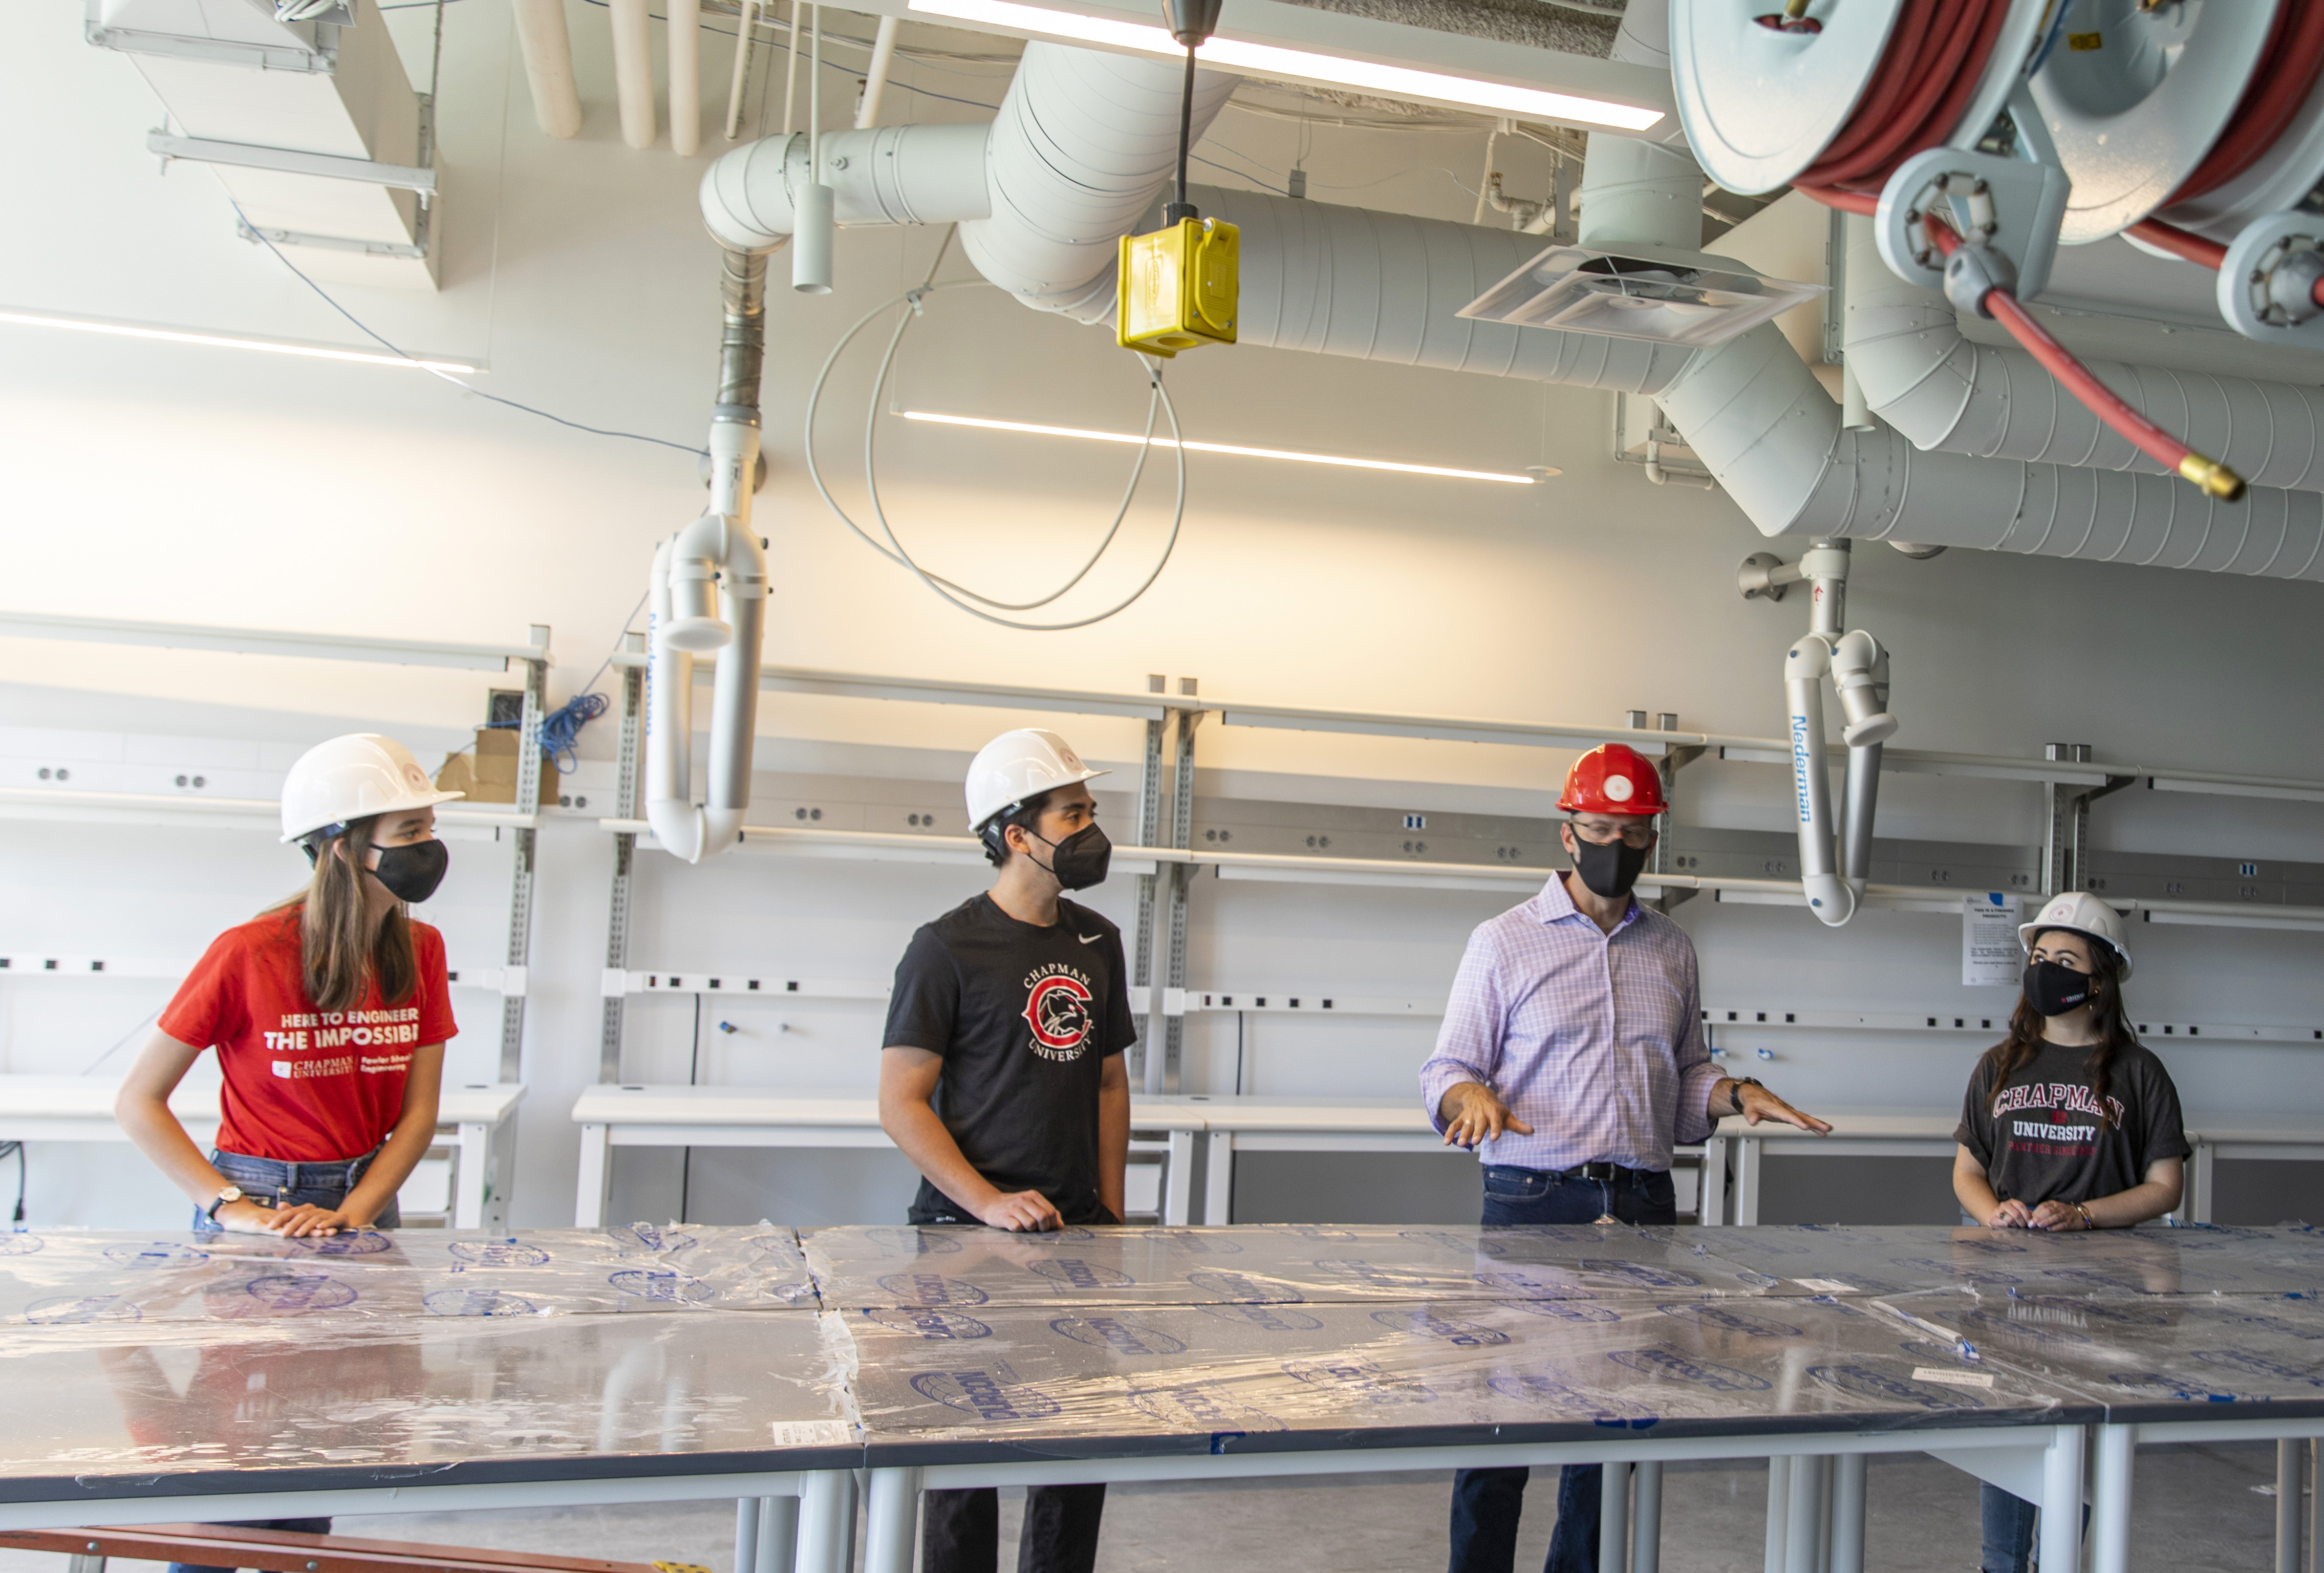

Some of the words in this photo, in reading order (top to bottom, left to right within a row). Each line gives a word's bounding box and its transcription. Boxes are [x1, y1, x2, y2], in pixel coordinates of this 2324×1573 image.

[1792, 715, 1811, 823] Nederman
[1024, 963, 1091, 989] CHAPMAN
[281, 1013, 318, 1028] HERE
[320, 1012, 343, 1025] TO
[347, 1007, 419, 1024] ENGINEER
[264, 1030, 308, 1050] THE
[1028, 1037, 1092, 1062] UNIVERSITY
[293, 1055, 353, 1071] CHAPMAN
[1993, 1083, 2125, 1130] CHAPMAN
[2013, 1121, 2096, 1141] UNIVERSITY
[2008, 1140, 2051, 1155] PANTHER
